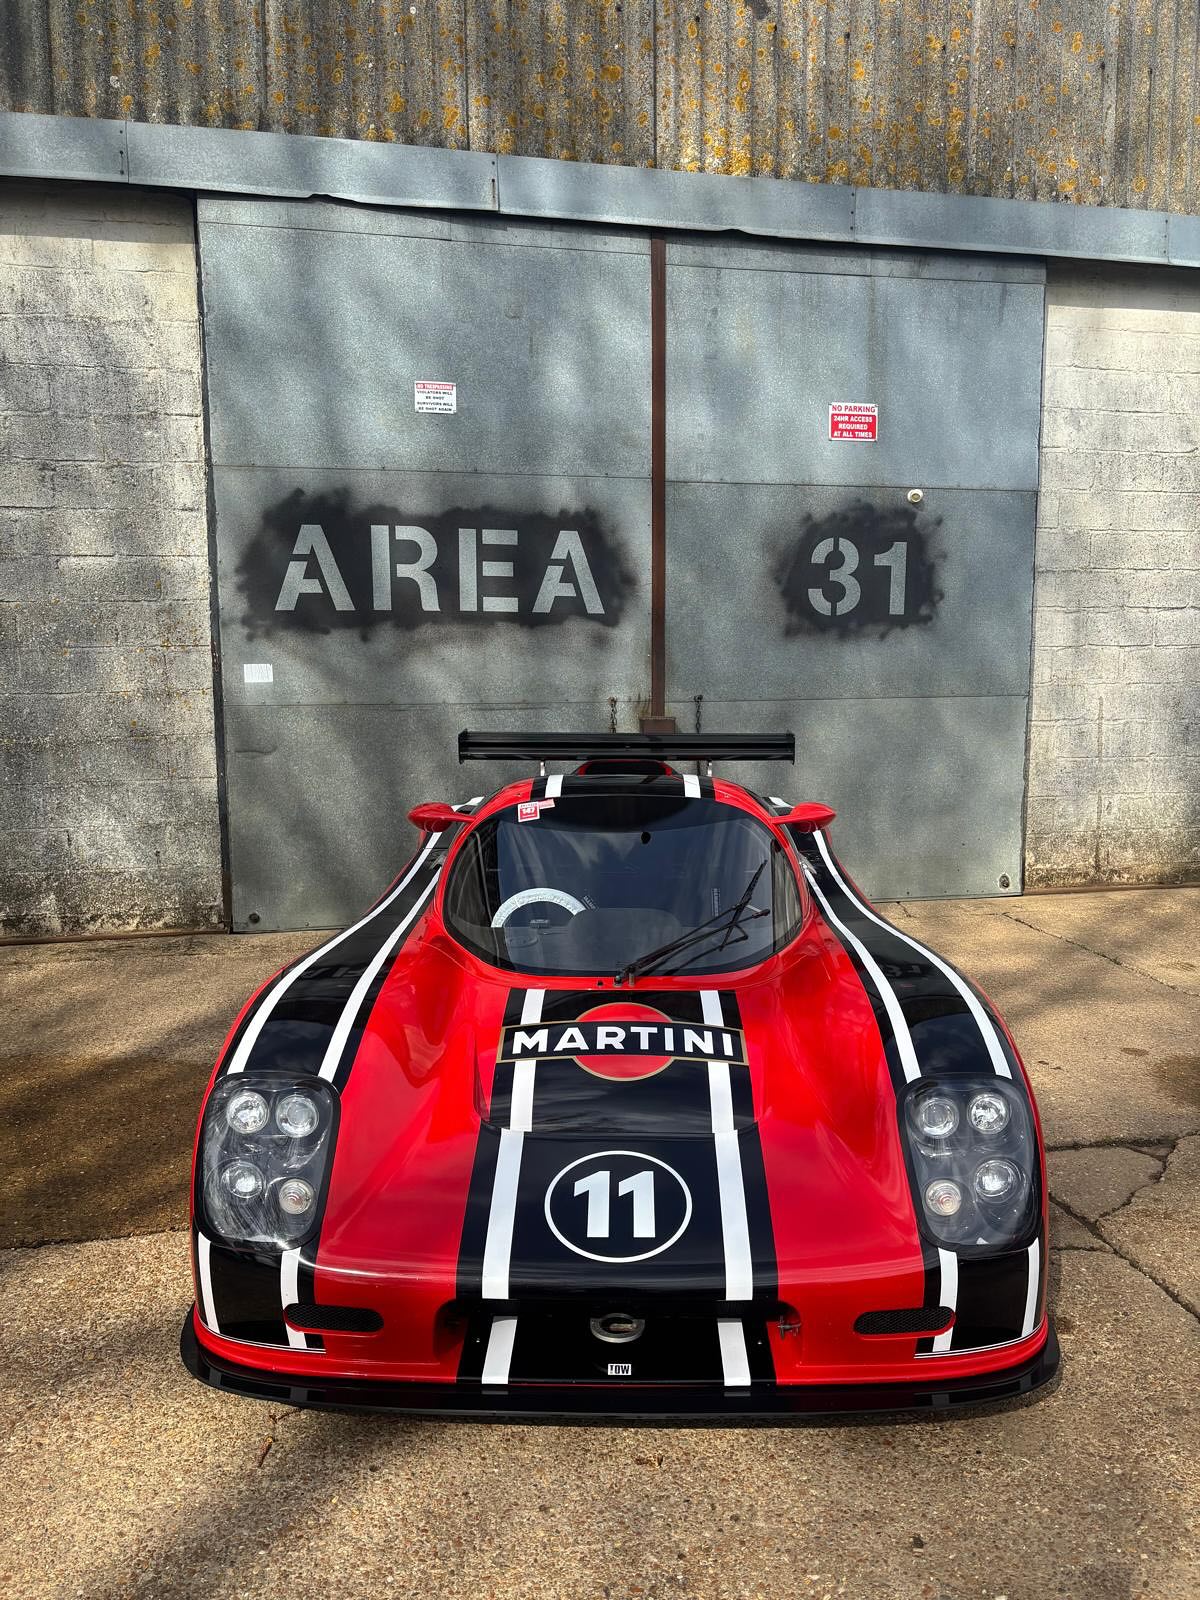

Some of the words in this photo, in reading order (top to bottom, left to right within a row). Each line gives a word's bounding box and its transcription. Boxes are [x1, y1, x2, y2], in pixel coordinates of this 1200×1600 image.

[844, 405, 876, 413] PARKING
[274, 524, 605, 615] AREA
[807, 536, 908, 617] 31
[512, 1026, 735, 1057] MARTINI
[573, 1170, 656, 1239] 11
[609, 1364, 630, 1375] TOW
